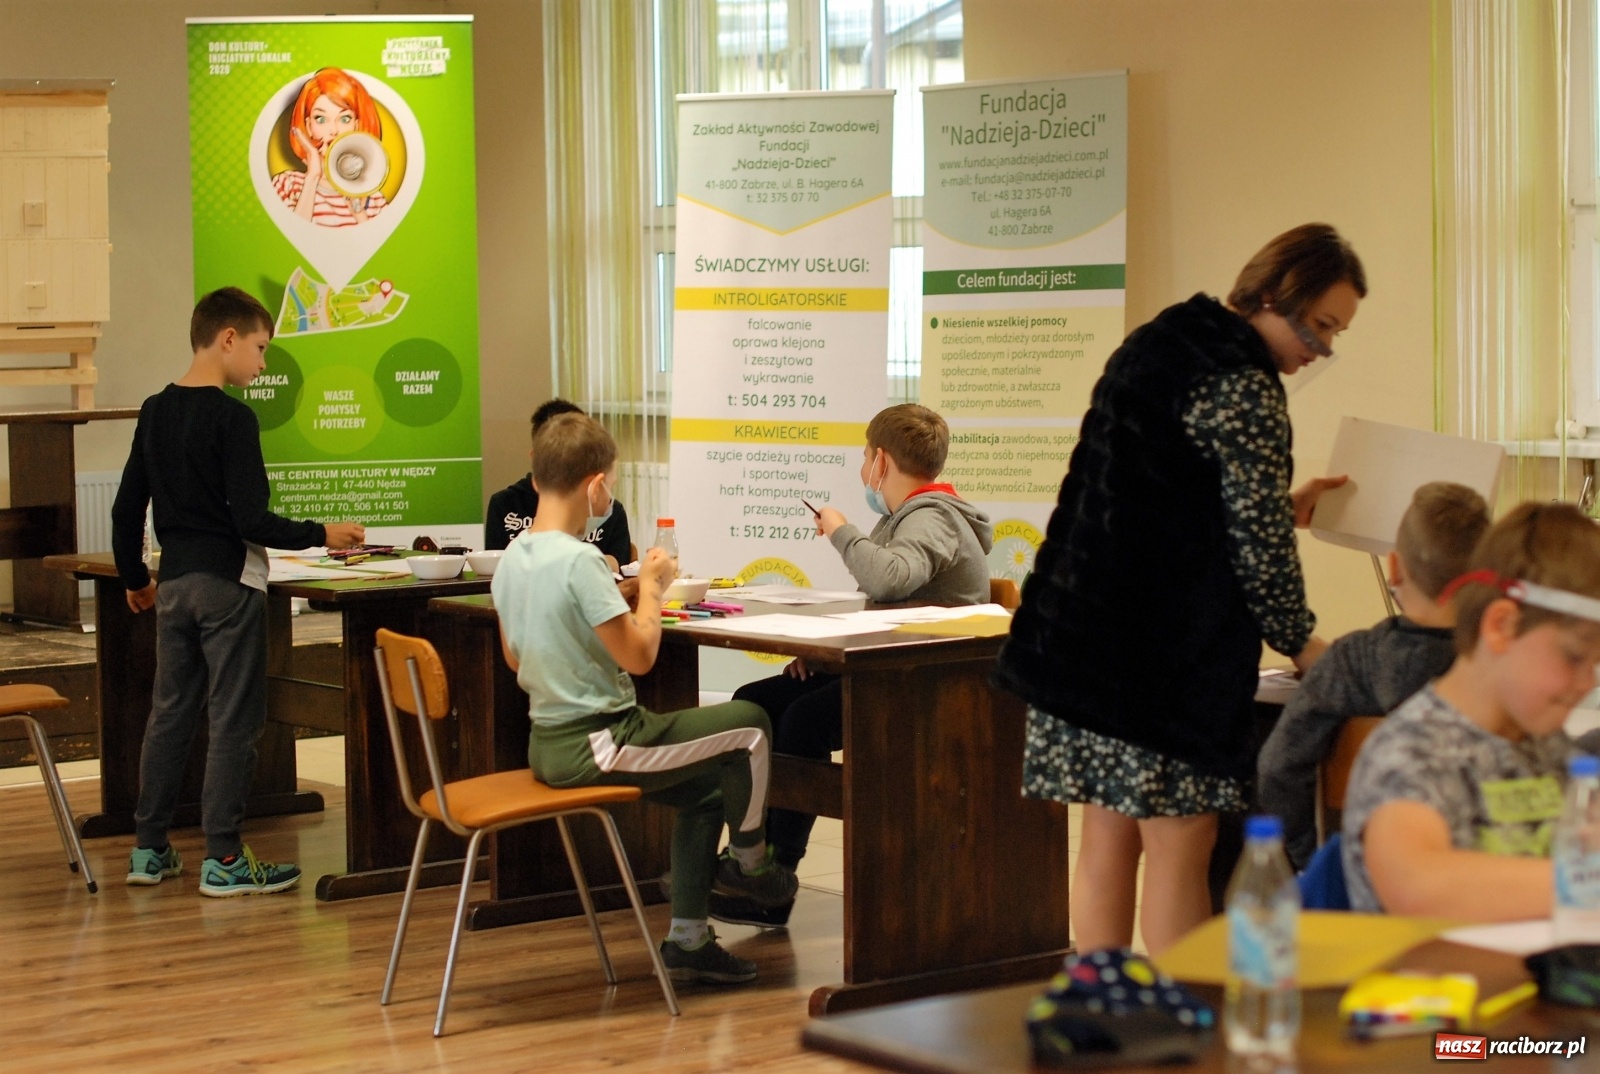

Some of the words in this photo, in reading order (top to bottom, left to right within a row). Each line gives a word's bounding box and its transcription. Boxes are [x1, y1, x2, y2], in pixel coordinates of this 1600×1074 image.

[208, 42, 226, 52] DOM
[208, 52, 254, 64] INICJATYWY
[257, 52, 292, 62] LOKALNE
[387, 50, 446, 60] KULTURALNY
[209, 64, 230, 75] 2020
[980, 88, 1067, 116] Fundacja
[692, 124, 734, 136] Zakład
[736, 122, 805, 137] Aktywności
[809, 120, 880, 134] Zawodowej
[942, 114, 1106, 148] "Nadzieja-Dzieci"
[759, 140, 810, 153] Fundacji
[939, 148, 1108, 170] www.fundacjanadziejadzieci.com.pl
[704, 179, 738, 190] 41-800
[740, 178, 780, 190] Zabrze,
[782, 178, 794, 189] ul.
[797, 178, 806, 189] B.
[810, 178, 848, 190] Hagera
[850, 177, 864, 188] 6A
[941, 172, 972, 187] e-mail:
[974, 166, 1105, 186] fundacja@nadziejadzieci.pl
[756, 193, 768, 204] 32
[770, 192, 788, 203] 375
[791, 192, 806, 203] 07
[808, 192, 820, 202] 70
[994, 190, 1010, 201] +48
[1012, 189, 1023, 200] 32
[1025, 186, 1072, 200] 375-07-70
[990, 207, 1000, 219] ul.
[1003, 206, 1038, 220] Hagera
[1040, 206, 1052, 216] 6A
[988, 224, 1018, 236] 41-800
[1020, 222, 1054, 234] Zabrze
[694, 254, 800, 273] ŚWIADCZYMY
[805, 257, 870, 273] USŁUGI:
[956, 273, 996, 289] Celem
[999, 270, 1048, 290] fundacji
[1050, 270, 1076, 289] jest:
[714, 292, 848, 307] INTROLIGATORSKIE
[748, 318, 812, 331] falcowanie
[942, 318, 985, 328] Niesienie
[986, 316, 1029, 328] wszelkiej
[1030, 316, 1068, 328] pomocy
[732, 338, 778, 350] oprawa
[781, 336, 826, 350] klejona
[942, 333, 984, 345] dzieciom,
[986, 332, 1030, 345] młodzieży
[1032, 334, 1050, 343] oraz
[1052, 331, 1095, 344] dorosłym
[744, 354, 748, 366] i
[751, 354, 813, 368] zeszytowa
[942, 348, 1005, 362] upośledzonym
[1006, 349, 1010, 359] i
[1011, 348, 1084, 361] pokrzywdzonym
[395, 370, 440, 382] DZIAŁAMY
[942, 365, 990, 377] społecznie,
[992, 364, 1041, 376] materialnie
[742, 372, 814, 386] wykrawanie
[402, 384, 433, 395] RAZEM
[941, 381, 956, 392] lub
[957, 380, 1008, 393] zdrowotnie,
[1010, 383, 1016, 392] a
[1017, 380, 1060, 392] zwłaszcza
[244, 389, 248, 400] I
[250, 388, 275, 401] WIĘZI
[324, 390, 354, 402] WASZE
[727, 394, 738, 406] t:
[742, 394, 768, 407] 504
[772, 394, 796, 408] 293
[800, 394, 826, 408] 704
[318, 404, 361, 416] POMYSŁY
[940, 398, 994, 410] zagrożonym
[996, 396, 1045, 409] ubóstwem,
[313, 418, 318, 430] I
[320, 417, 366, 430] POTRZEBY
[734, 424, 819, 440] KRAWIECKIE
[1001, 434, 1052, 446] zawodowa,
[706, 449, 743, 464] szycie
[746, 450, 791, 464] odzieży
[794, 452, 846, 468] roboczej
[992, 449, 1014, 460] osób
[288, 470, 339, 480] CENTRUM
[341, 468, 388, 478] KULTURY
[390, 468, 400, 477] W
[402, 466, 436, 478] NĘDZY
[742, 468, 746, 479] i
[750, 470, 808, 483] sportowej
[976, 466, 1032, 477] prowadzenie
[276, 481, 322, 492] Strażacka
[323, 480, 330, 490] 2
[342, 480, 374, 489] 47-440
[376, 479, 407, 490] Nędza
[976, 481, 1026, 494] Aktywności
[280, 491, 403, 502] centrum.nedza@gmail.com
[720, 484, 744, 496] haft
[748, 485, 830, 502] komputerowy
[273, 505, 288, 514] tel.
[290, 504, 302, 513] 32
[303, 504, 320, 513] 410
[323, 503, 334, 512] 47
[354, 502, 372, 511] 506
[374, 502, 390, 510] 141
[392, 500, 410, 510] 501
[743, 504, 806, 518] przeszycia
[730, 525, 740, 538] t:
[744, 526, 764, 538] 512
[769, 526, 790, 540] 212
[794, 527, 817, 540] 677
[742, 561, 804, 586] FUNDACJA
